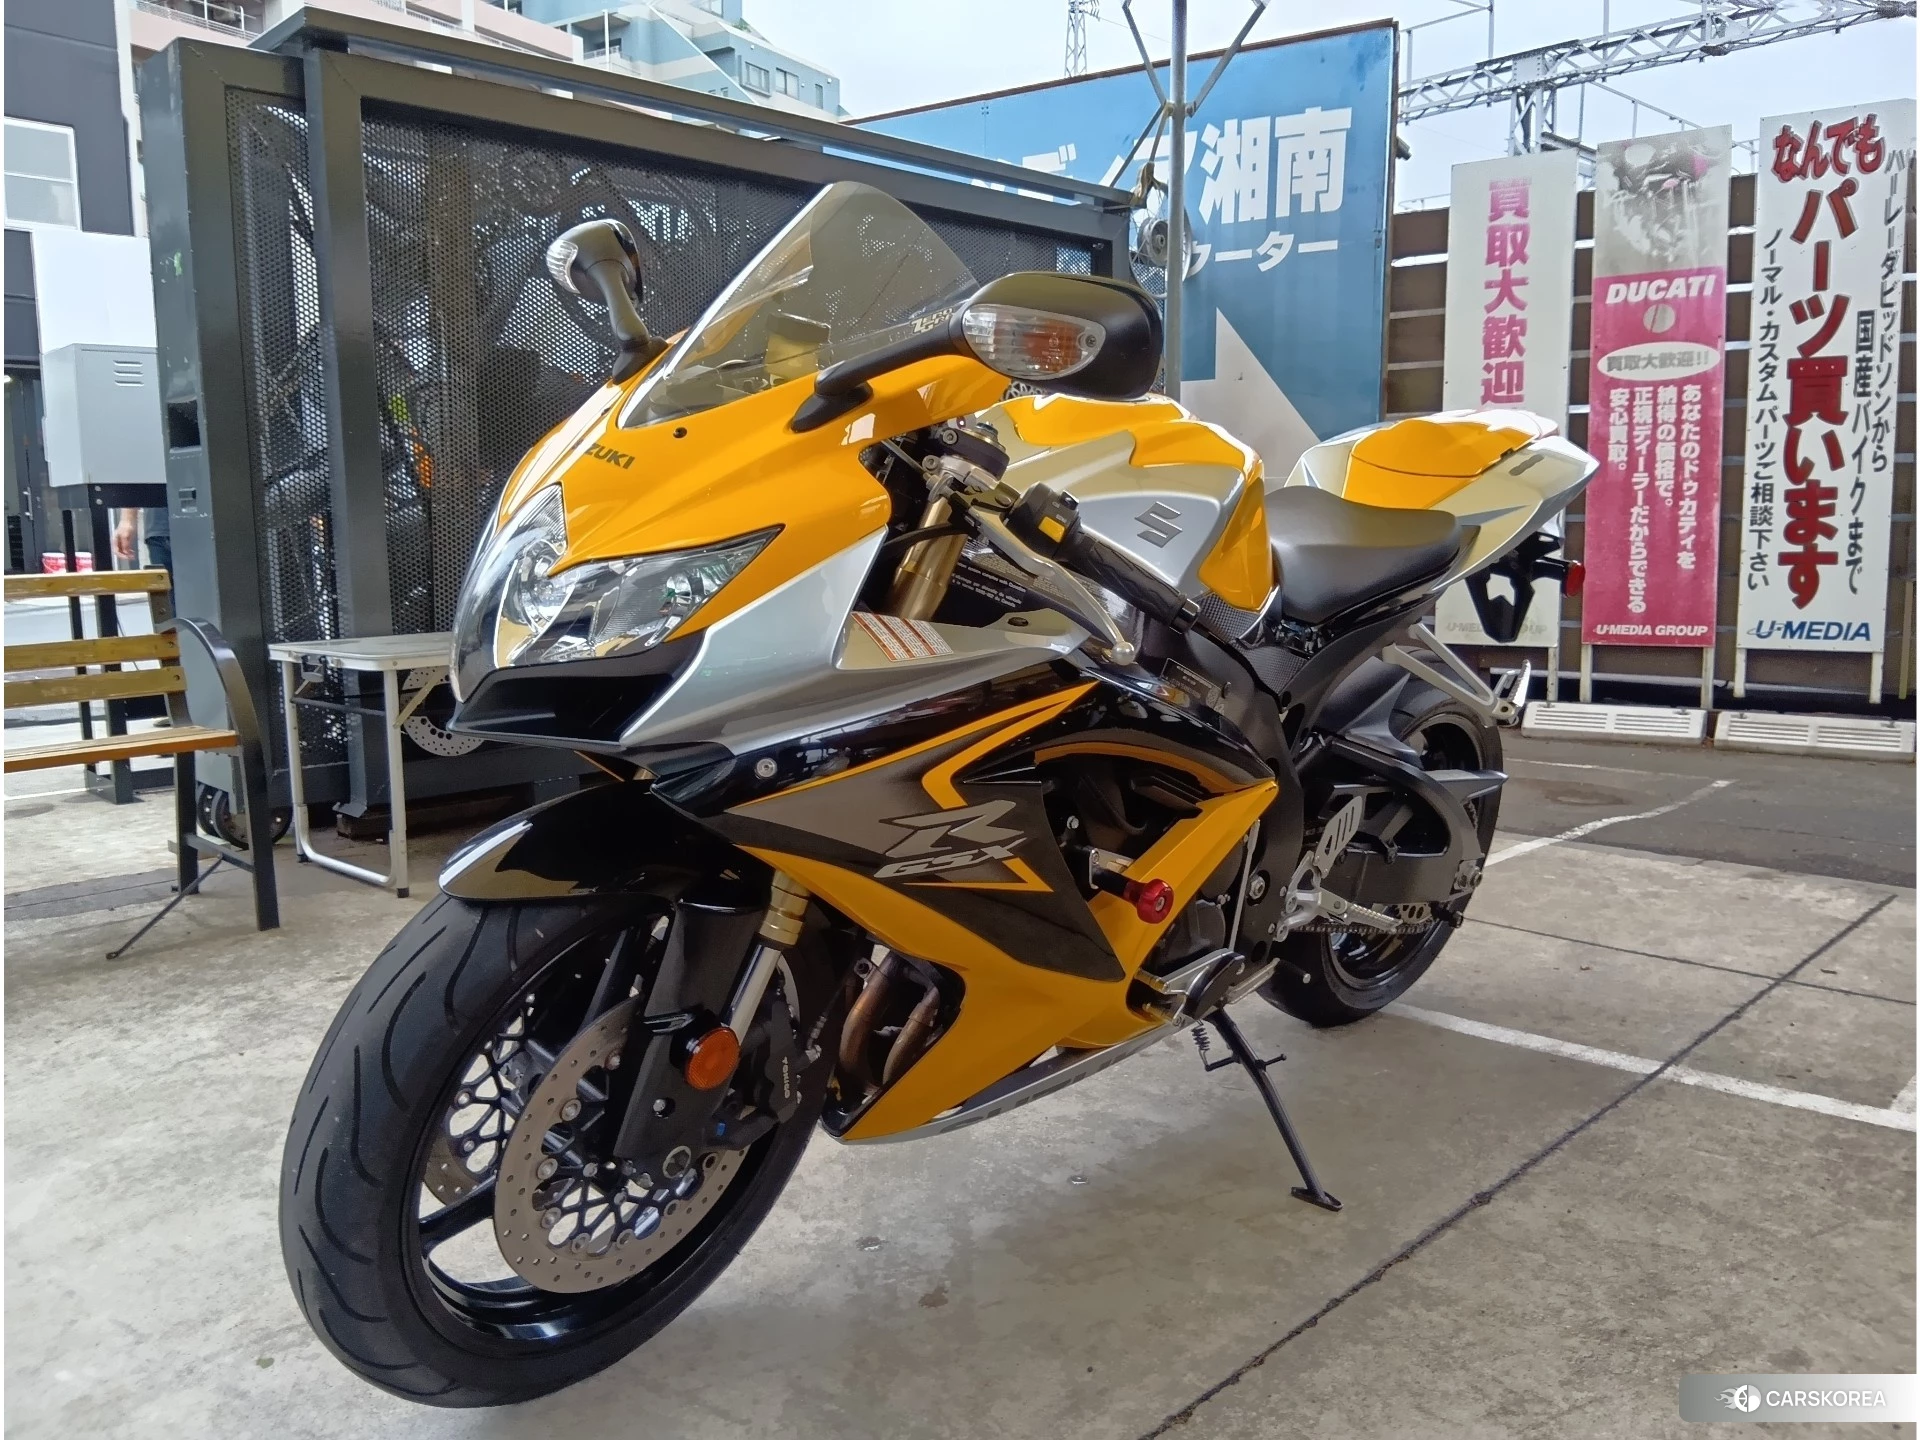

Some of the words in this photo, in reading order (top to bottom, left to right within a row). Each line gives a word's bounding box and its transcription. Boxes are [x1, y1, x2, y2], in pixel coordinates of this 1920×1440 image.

[1771, 113, 1886, 183] なんでも
[1480, 177, 1532, 406] 買取大歓迎
[1605, 274, 1716, 304] DUCATI
[1872, 149, 1904, 472] ハーレーダビッドソンから
[584, 442, 636, 470] ZUKI
[1607, 388, 1630, 471] 安心買取。
[1654, 385, 1678, 507] 納得の価格で。
[1676, 384, 1702, 570] あなたのドゥカティを
[1747, 227, 1783, 591] ノーマル・カスタムパーツご相談下さい
[1777, 177, 1860, 610] パーツ買います
[1845, 310, 1877, 595] 国産バイクまで
[1627, 386, 1654, 614] 正規ディーラーだからできる
[1654, 625, 1708, 637] GROUP
